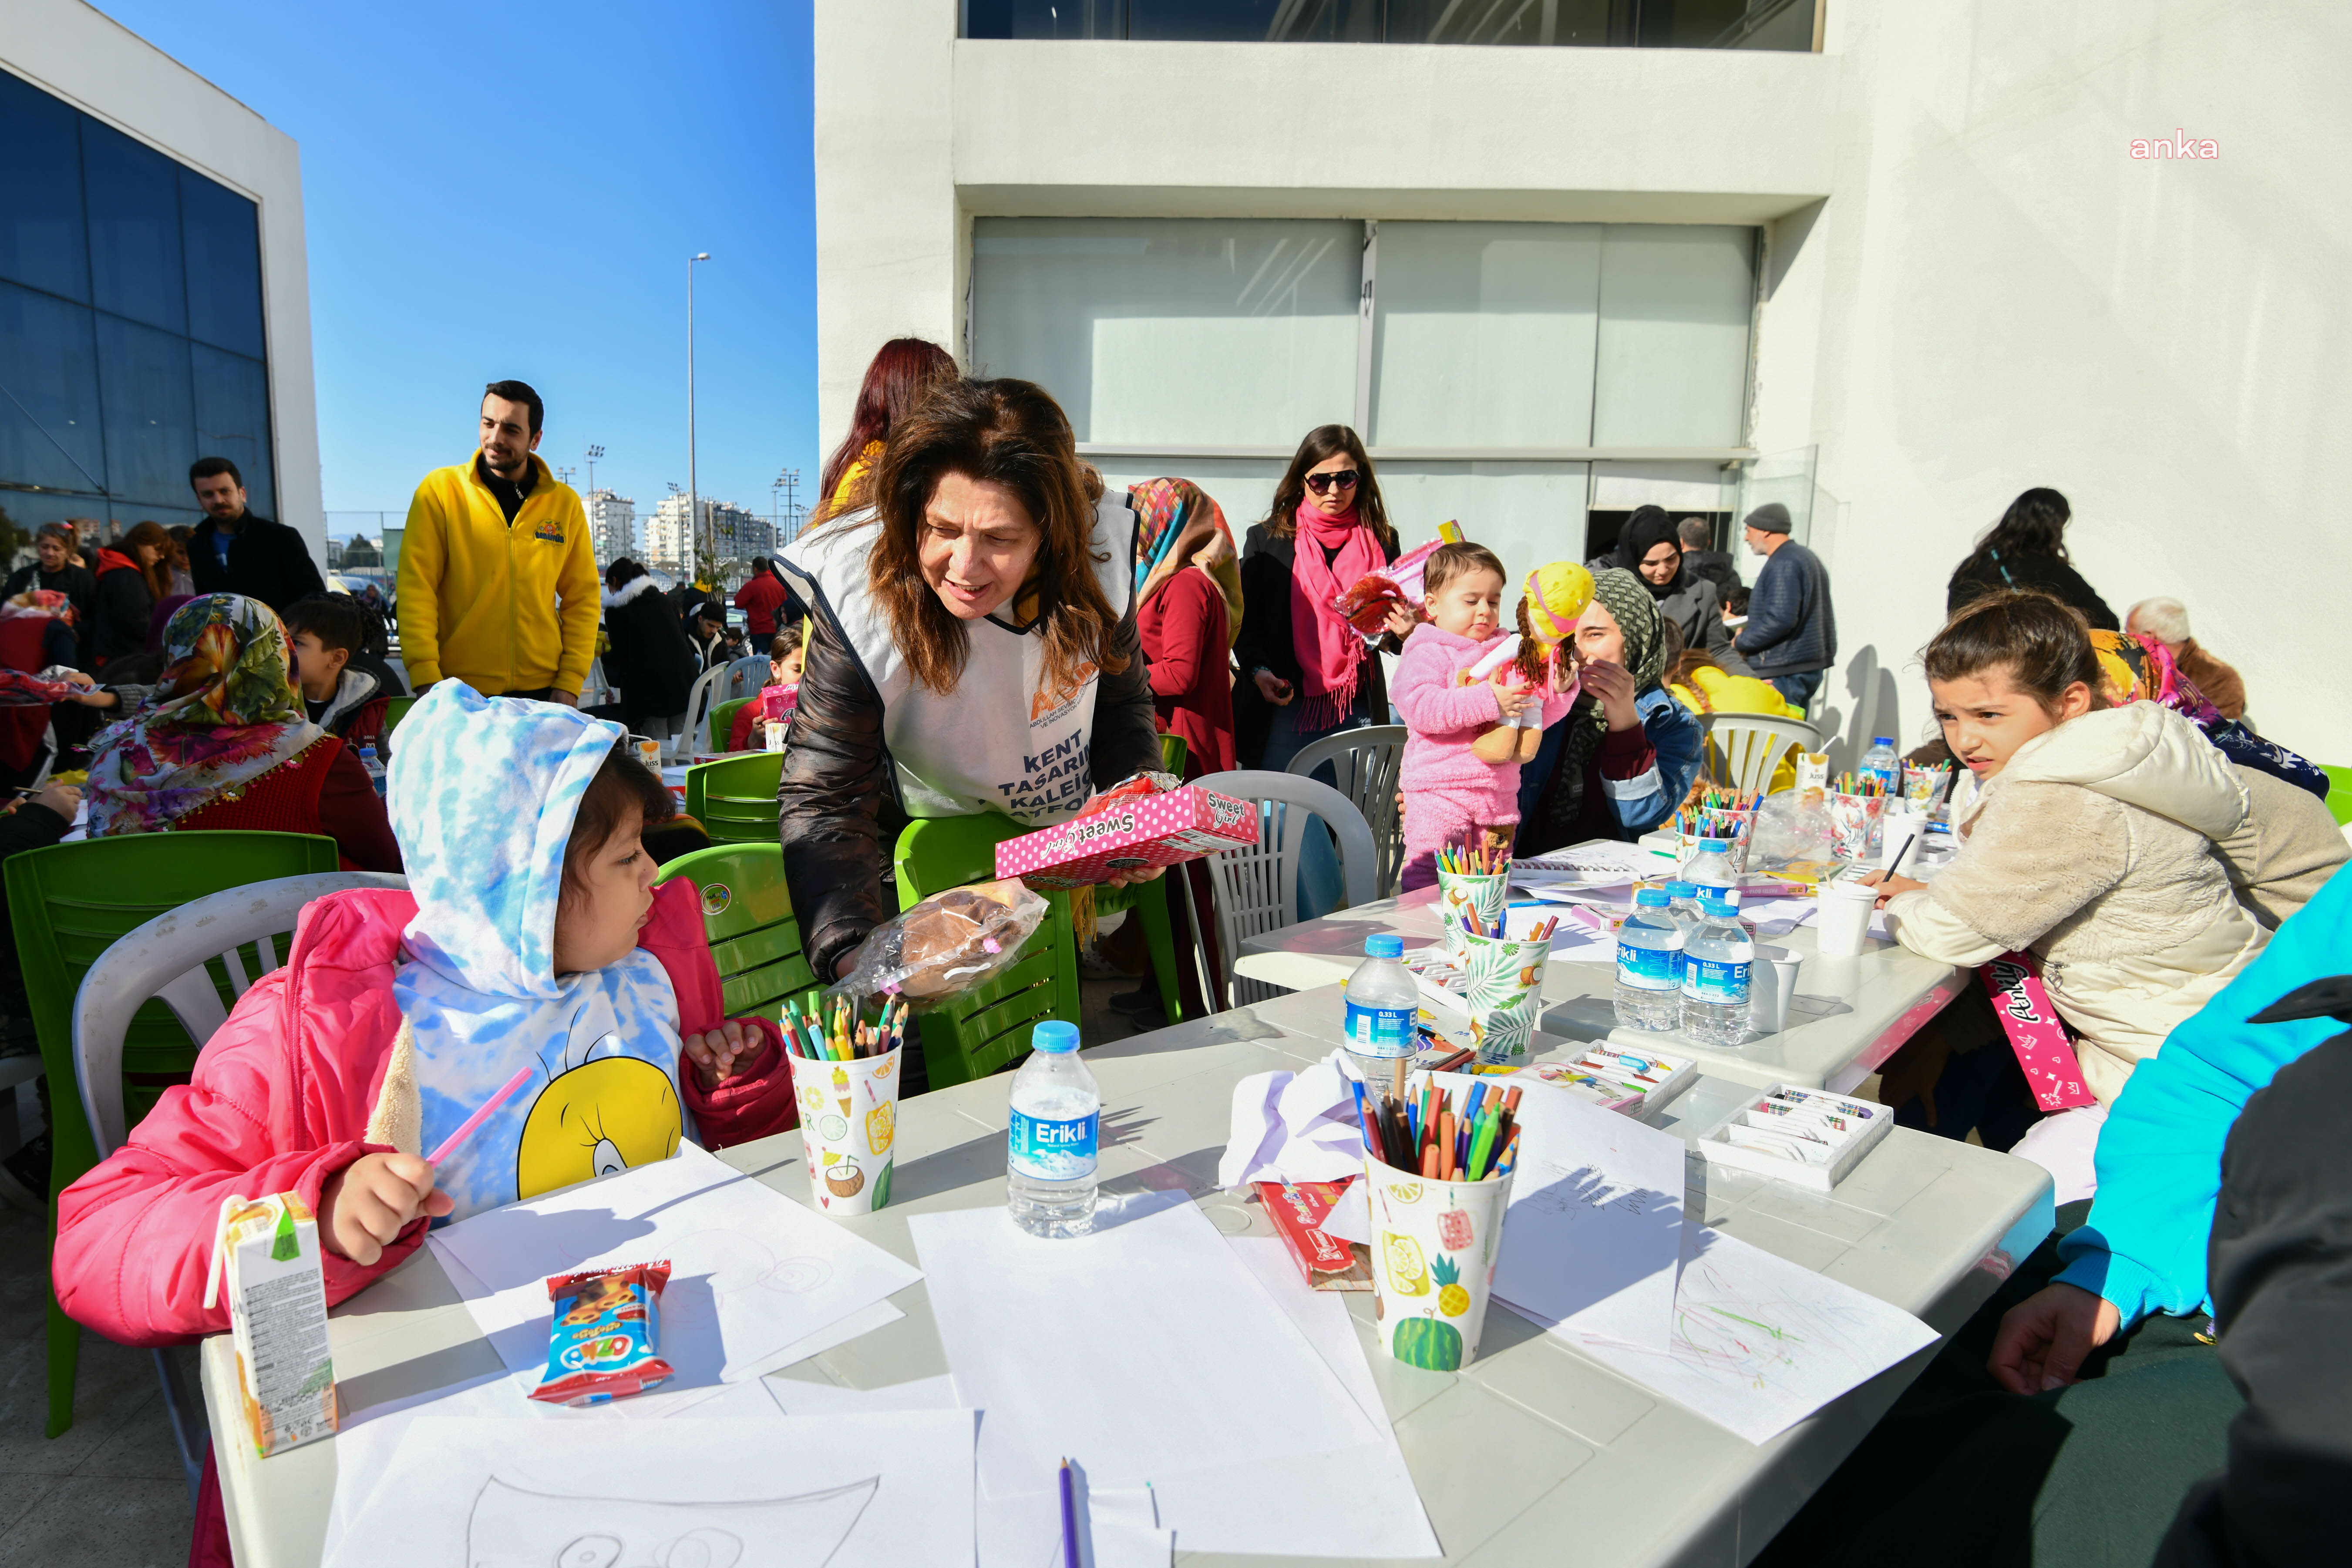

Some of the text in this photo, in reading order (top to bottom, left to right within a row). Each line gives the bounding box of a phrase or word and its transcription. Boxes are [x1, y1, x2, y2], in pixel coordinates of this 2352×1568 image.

[1030, 711, 1057, 729] ABDULLAH
[1049, 704, 1077, 724] İNOVASYON
[1023, 728, 1081, 773] KENT
[1208, 793, 1245, 816] Sweet
[1214, 806, 1240, 828] Girl
[1080, 814, 1133, 844] Sweet
[1041, 824, 1079, 860] Girl
[1036, 1121, 1086, 1144] Erikli
